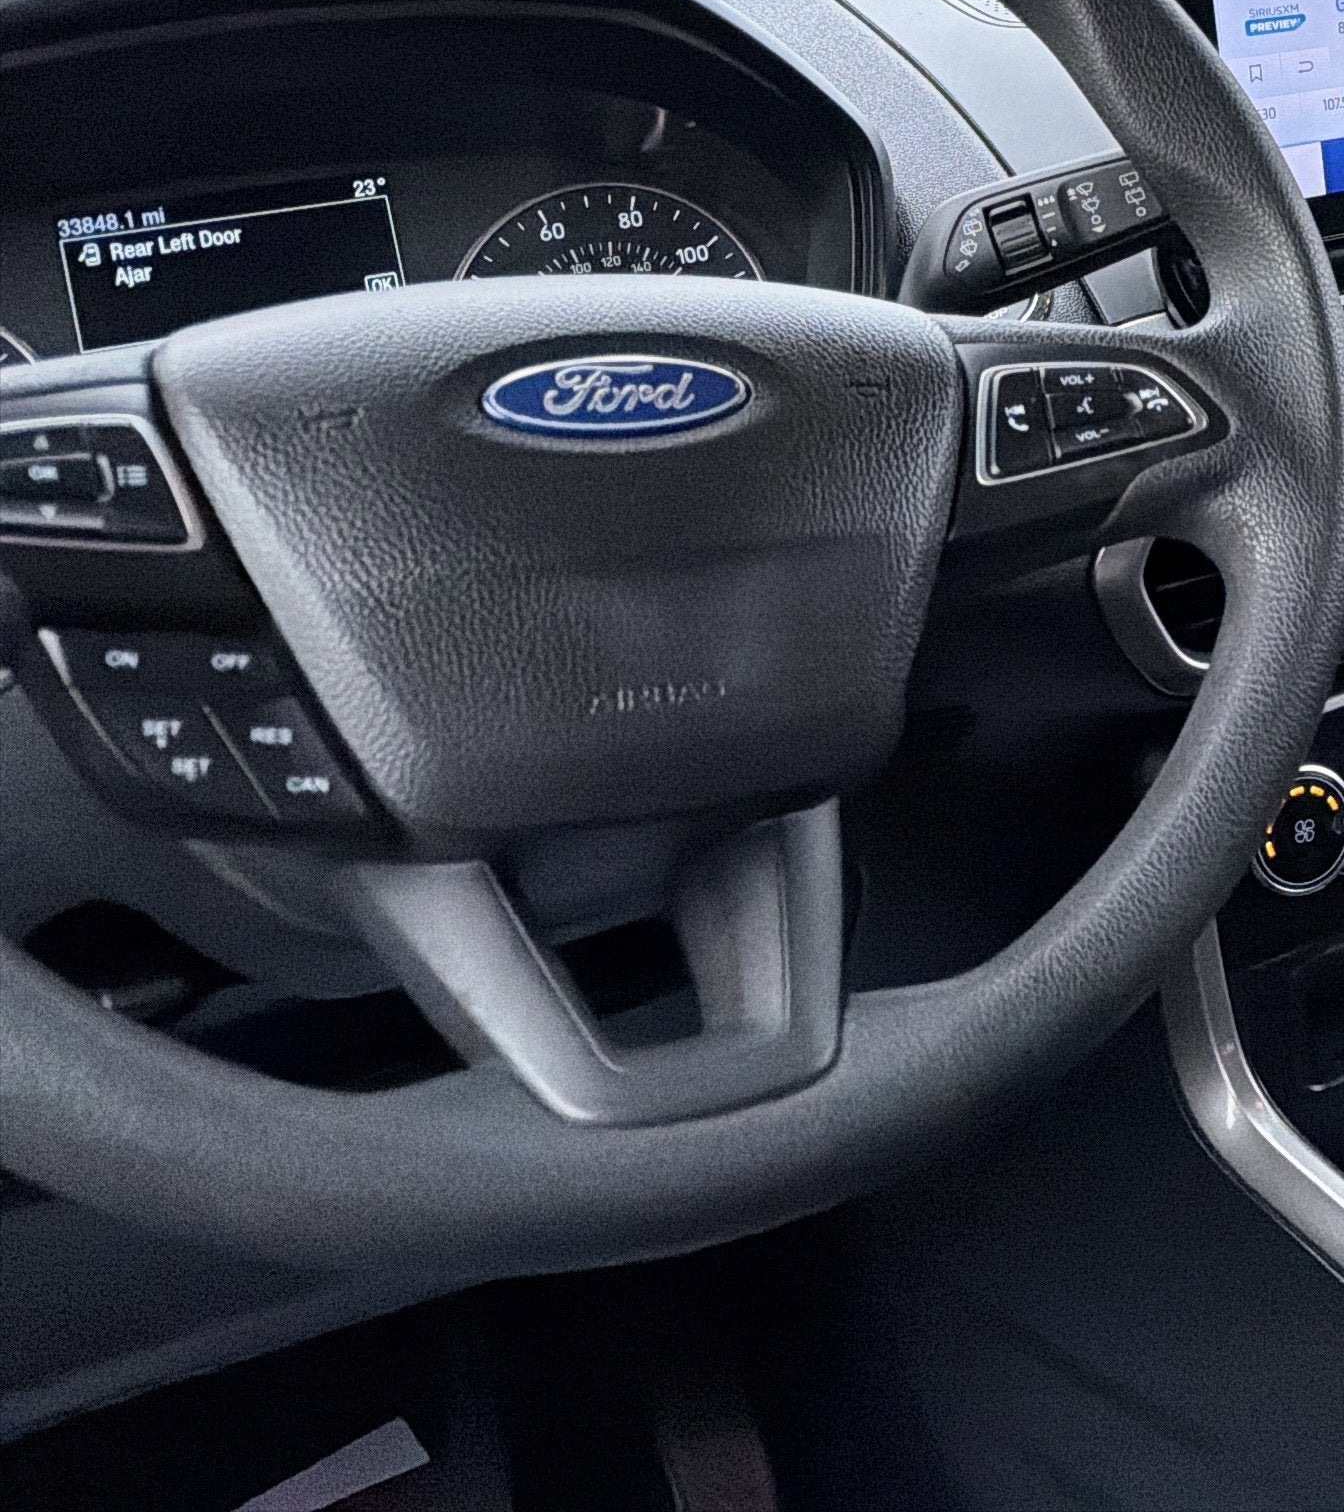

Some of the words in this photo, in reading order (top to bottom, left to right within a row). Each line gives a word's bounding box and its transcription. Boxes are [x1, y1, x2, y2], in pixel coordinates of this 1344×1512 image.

[1249, 3, 1300, 18] SIRIUSXM
[1250, 19, 1298, 33] PREVIEW
[353, 178, 386, 197] 23°
[58, 210, 135, 238] 33848.1
[141, 206, 166, 227] mi
[618, 210, 643, 229] 80
[540, 223, 565, 241] 60
[110, 241, 154, 262] Rear
[158, 232, 196, 254] Left
[199, 227, 242, 249] Door
[601, 255, 622, 268] 120
[676, 244, 709, 264] 100
[570, 262, 592, 274] 100
[630, 261, 652, 273] 140
[115, 266, 153, 288] Ajar
[543, 363, 694, 415] Ford
[105, 649, 139, 669] ON
[211, 653, 250, 671] OFF
[251, 727, 293, 745] RES
